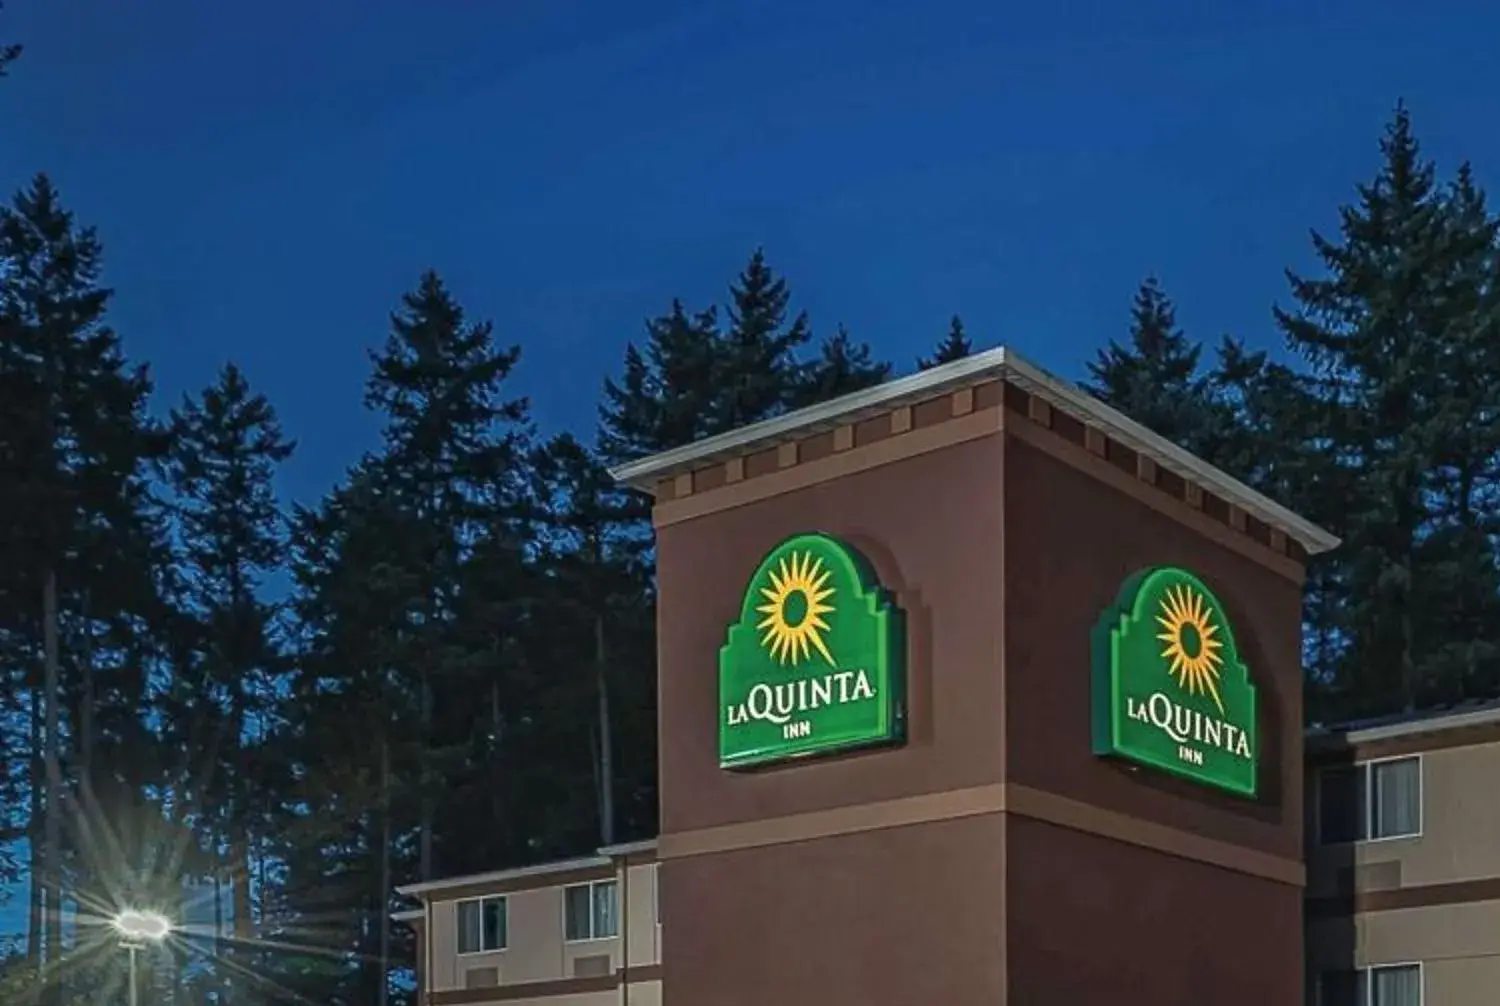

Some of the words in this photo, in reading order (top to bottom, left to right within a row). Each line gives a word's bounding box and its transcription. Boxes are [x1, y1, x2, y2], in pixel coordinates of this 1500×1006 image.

[748, 669, 874, 723] QUINTA
[783, 720, 811, 739] INN
[1149, 692, 1251, 758] QUINTA
[1179, 745, 1203, 765] INN
